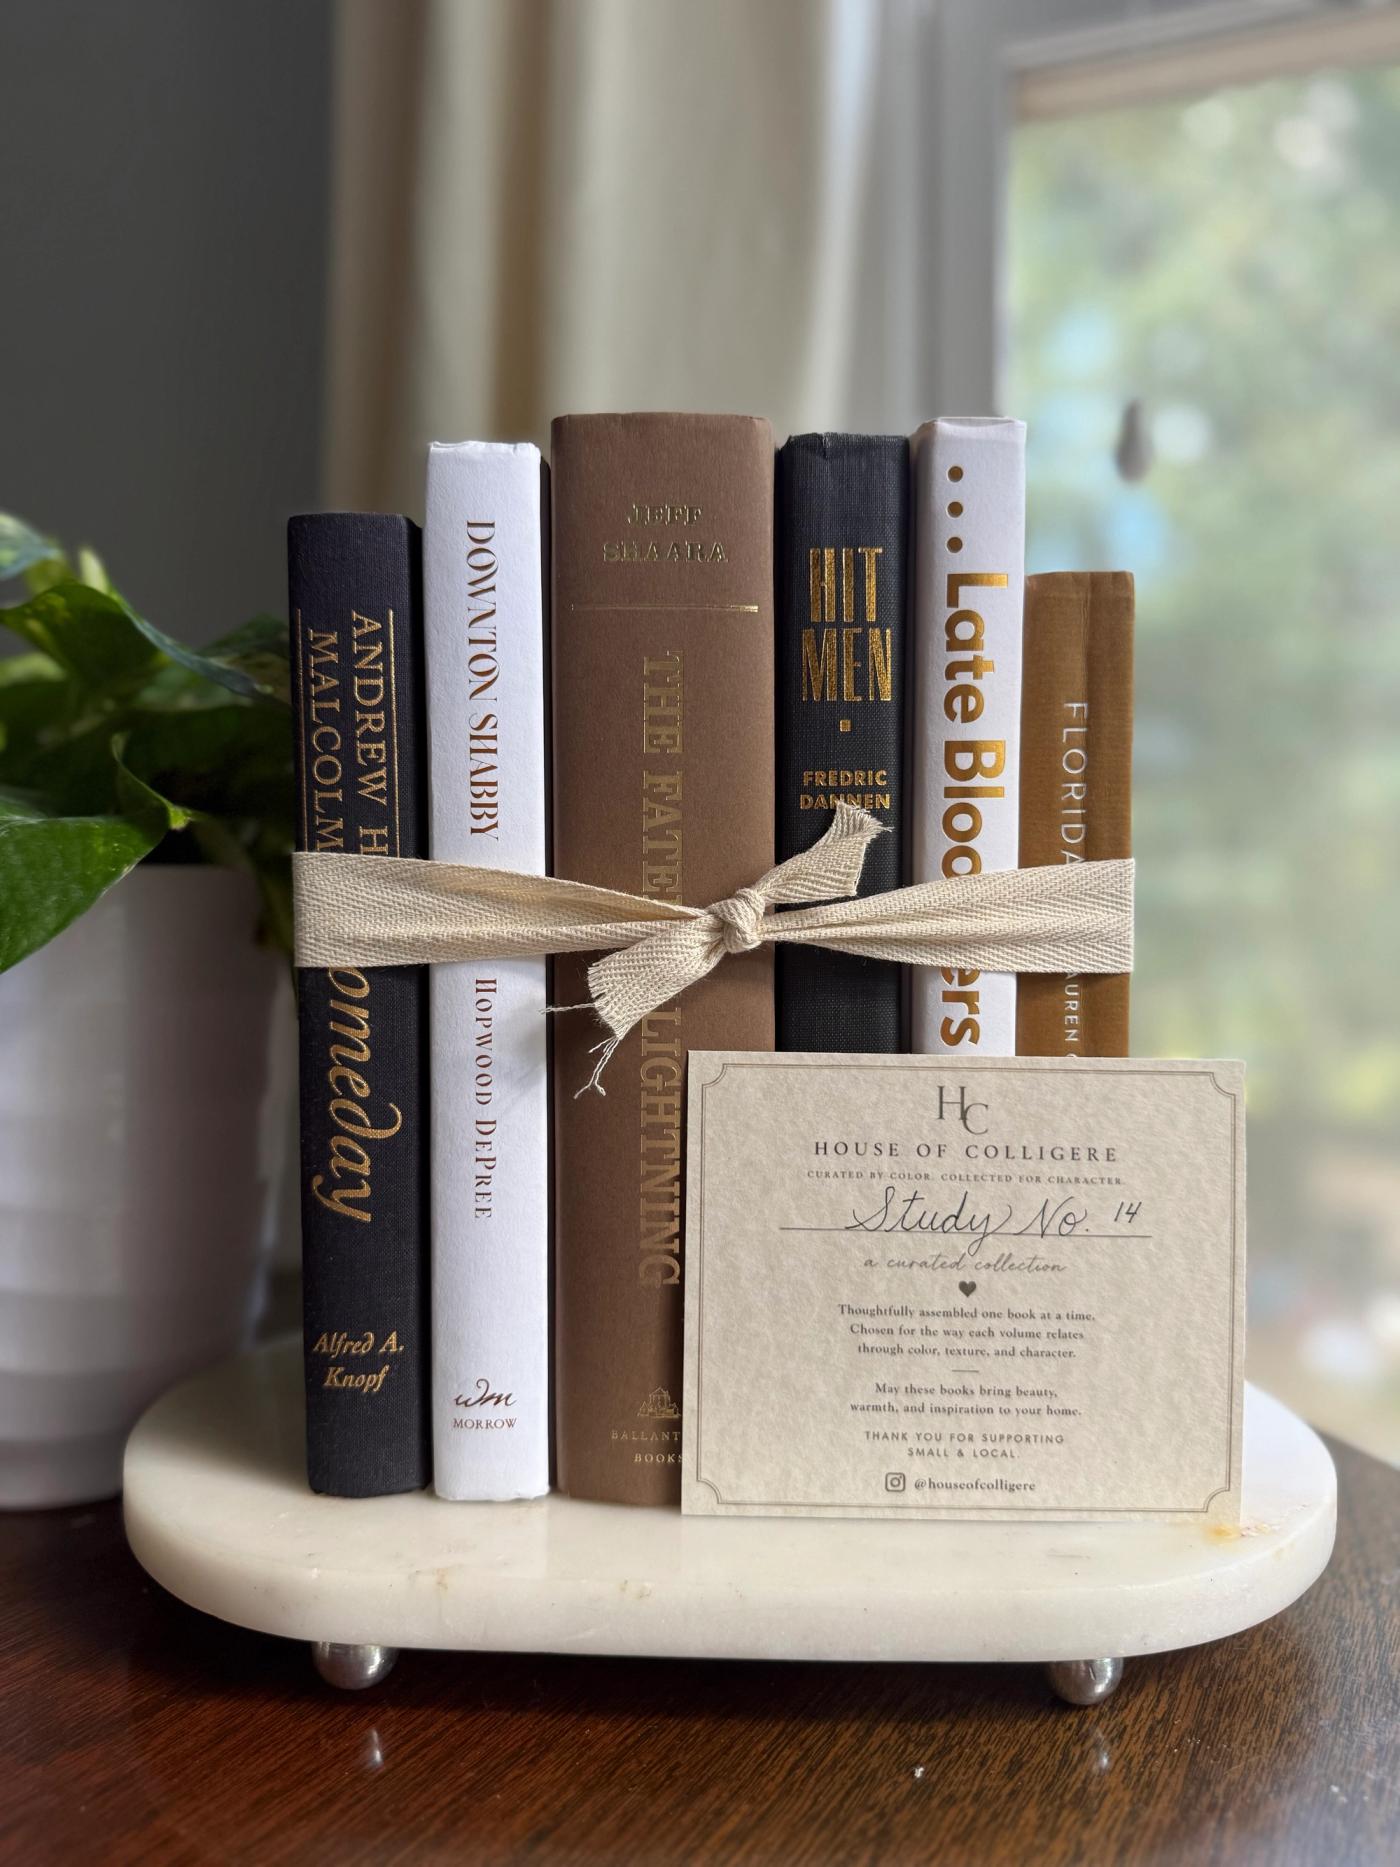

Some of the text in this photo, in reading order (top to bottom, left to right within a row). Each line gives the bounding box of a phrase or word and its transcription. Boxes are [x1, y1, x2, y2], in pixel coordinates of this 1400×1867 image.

[627, 504, 702, 525] JEFF
[603, 543, 728, 562] SHAARA
[810, 547, 882, 622] HIT
[944, 573, 1008, 724] Late
[801, 628, 891, 701] MEN
[466, 520, 500, 839] DOWNTON SHABBY
[351, 610, 388, 806] ANDREW
[307, 629, 344, 851] MALCOLM
[803, 769, 887, 786] FREDRIC
[1060, 702, 1088, 864] FLORIDA
[800, 793, 891, 809] DANNEN
[638, 651, 683, 1288] THE FATE LIGHTNING
[311, 967, 401, 1222] omeday
[815, 1142, 1116, 1162] HOUSE OF COLLIGERE
[807, 1170, 863, 1180] CURATED
[869, 1172, 884, 1180] BY
[940, 1173, 1013, 1183] COLLECTED
[1018, 1174, 1042, 1184] FOR
[845, 1186, 1142, 1257] Study No. 14
[863, 1252, 1068, 1274] a curated collection
[838, 1304, 914, 1318] Thoughtfully
[919, 1307, 977, 1318] assembled
[1008, 1308, 1036, 1320] book
[1041, 1312, 1051, 1320] at
[1066, 1311, 1095, 1321] time.
[850, 1324, 1084, 1339] Chosen for the way each volume relates
[312, 1330, 404, 1359] Alfred A.
[858, 1343, 1076, 1359] through color, texture, and character.
[323, 1364, 390, 1392] Knopf
[875, 1383, 899, 1395] May
[905, 1384, 935, 1394] these
[940, 1384, 974, 1396] books
[980, 1385, 1011, 1398] bring
[851, 1402, 1081, 1416] warmth, and inspiration to your home.
[453, 1418, 518, 1430] MORROW
[611, 1430, 682, 1441] BALLANT
[865, 1431, 1064, 1444] THANK YOU FOR SUPPORTING
[908, 1448, 948, 1457] SMALL
[957, 1449, 964, 1458] &
[915, 1478, 1035, 1493] @houseofcolligere
